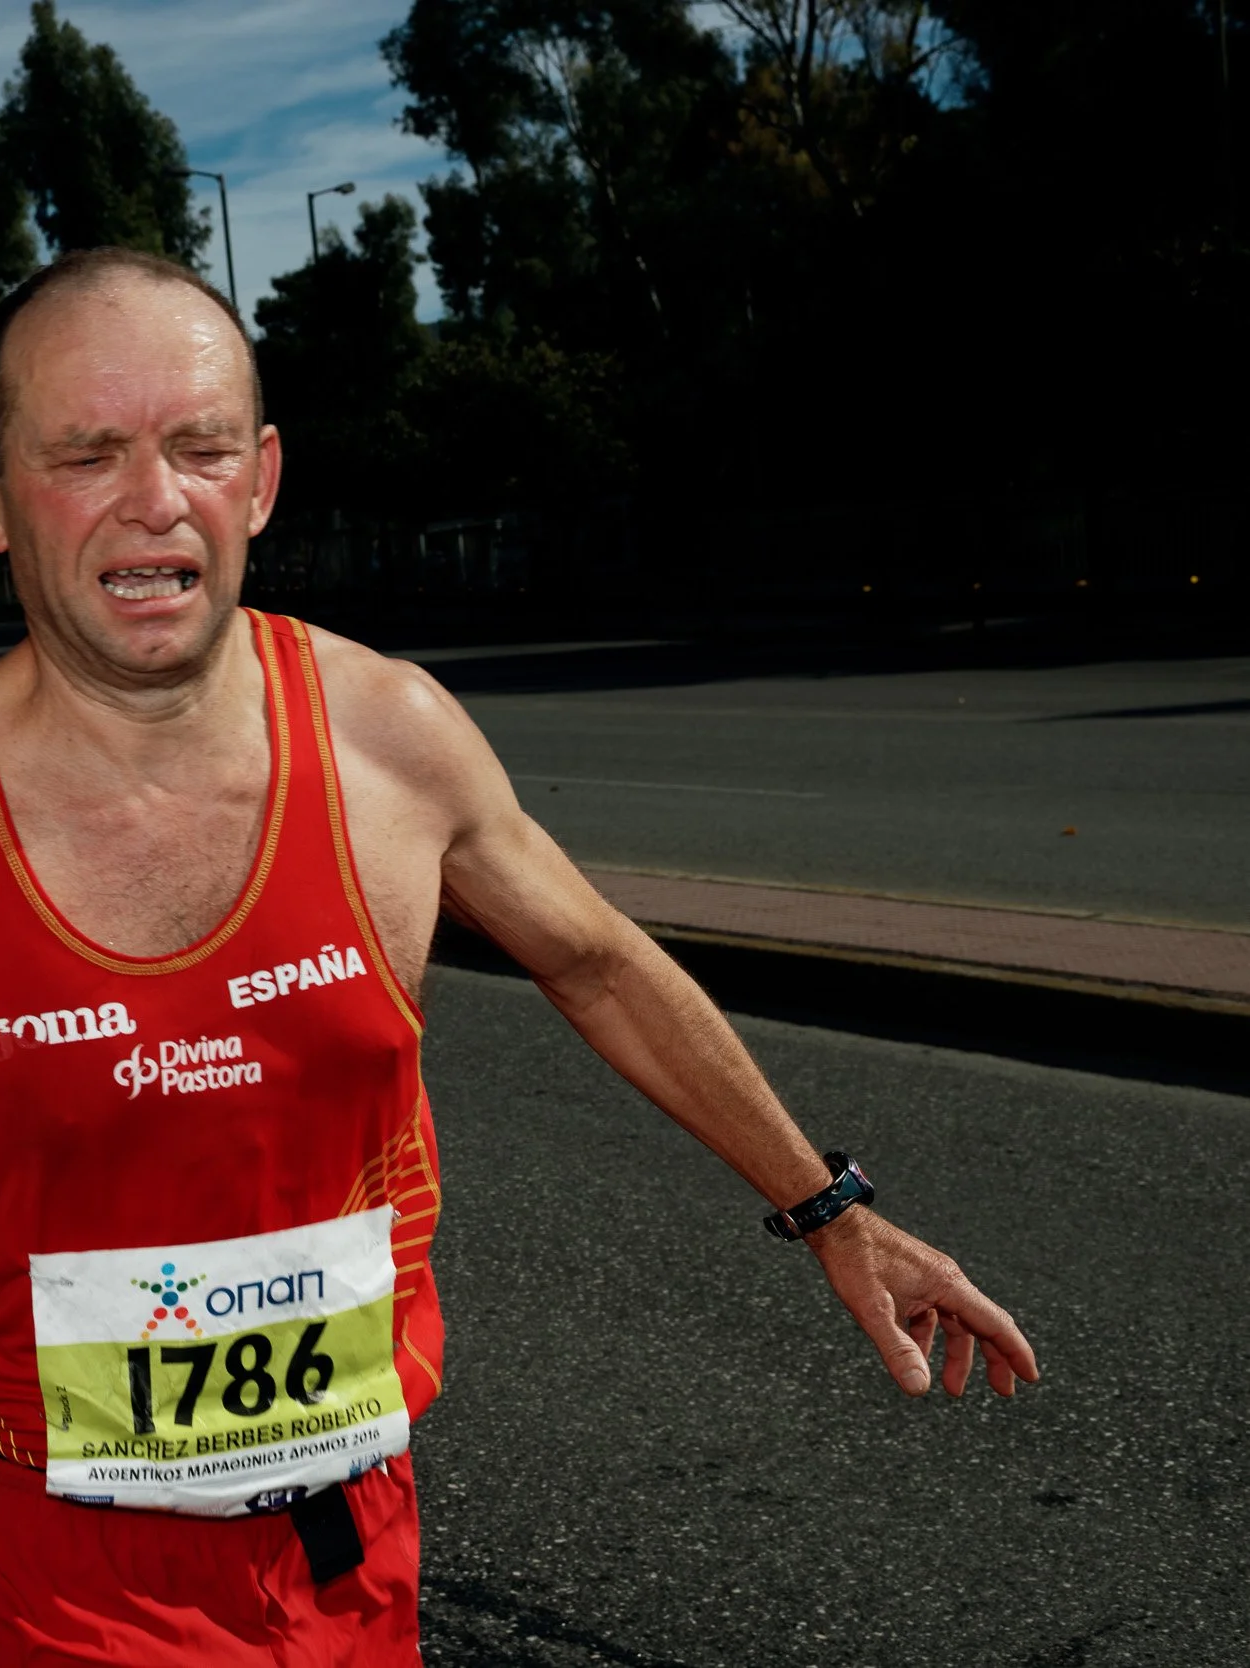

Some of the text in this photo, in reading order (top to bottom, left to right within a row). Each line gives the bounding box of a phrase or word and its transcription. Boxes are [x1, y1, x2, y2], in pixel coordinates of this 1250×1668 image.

[227, 943, 367, 1009] ESPAÑA
[159, 1035, 243, 1069] Divina
[160, 1059, 262, 1096] Pastora
[127, 1321, 335, 1436] 1786
[81, 1398, 383, 1459] SANCHEZ BERBES ROBERTO
